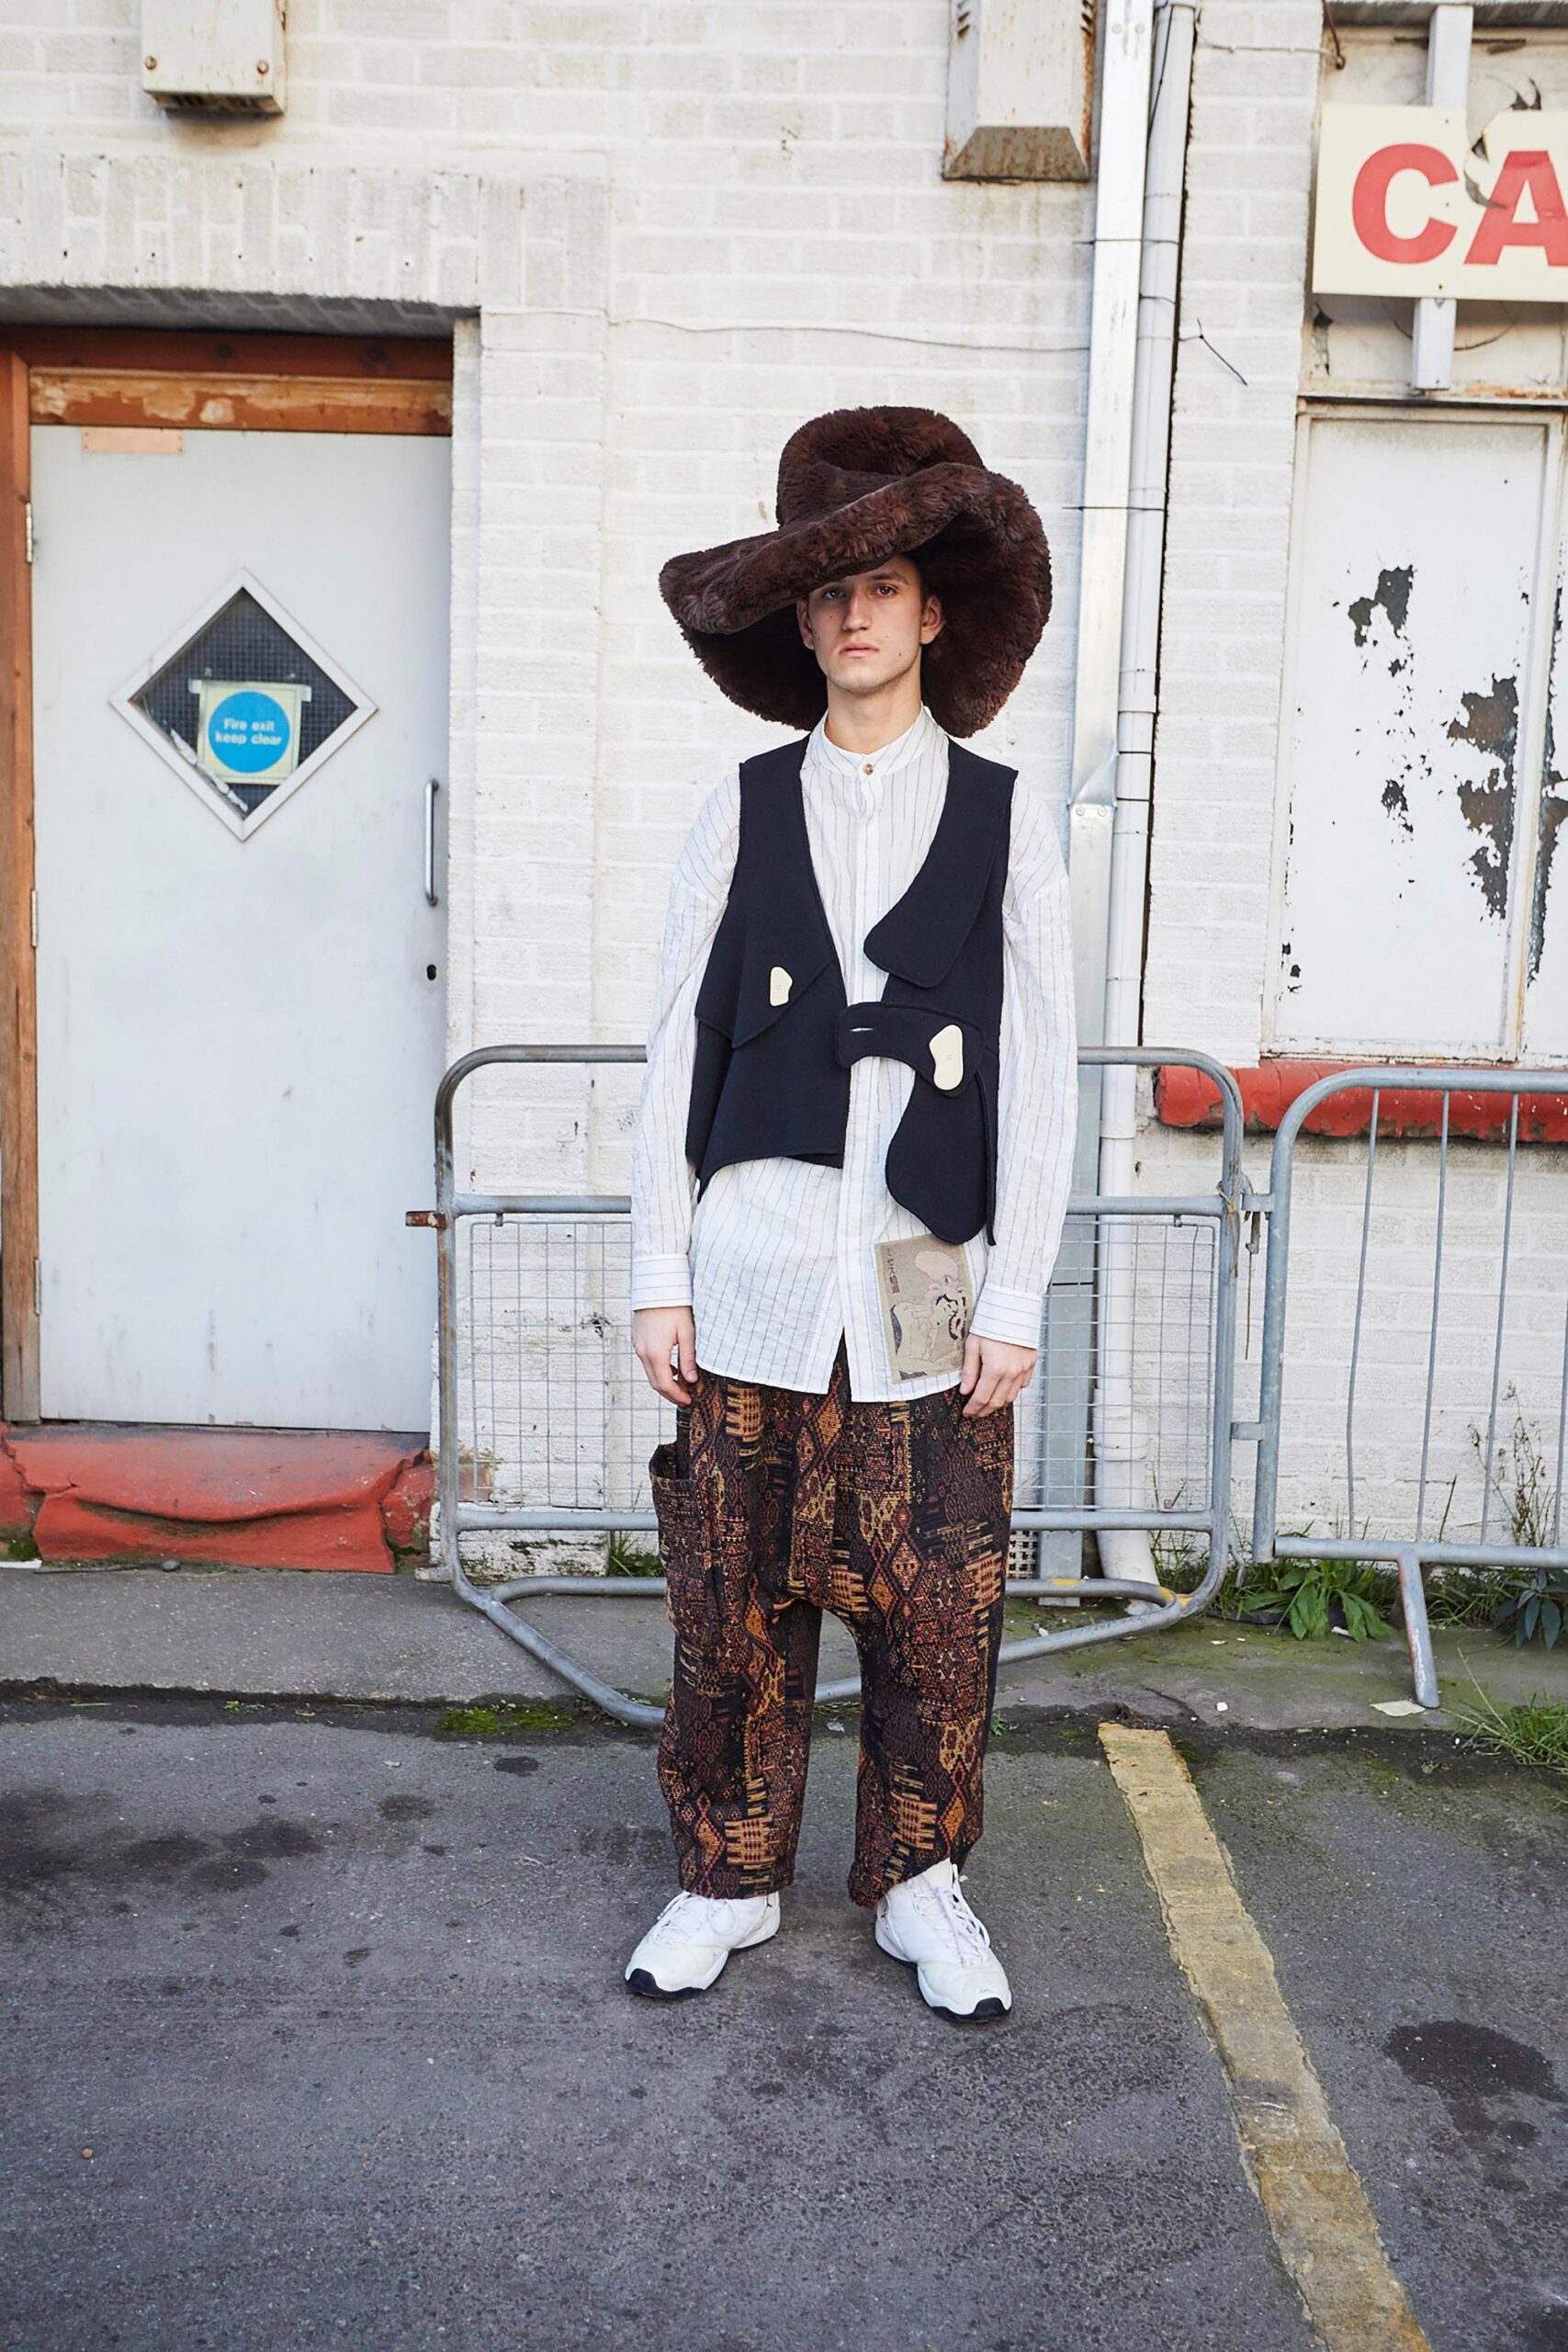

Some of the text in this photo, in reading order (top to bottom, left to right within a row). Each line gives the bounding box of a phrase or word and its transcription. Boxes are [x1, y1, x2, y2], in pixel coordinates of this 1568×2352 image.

[223, 718, 275, 731] Fire exit
[215, 730, 282, 745] keep clear
